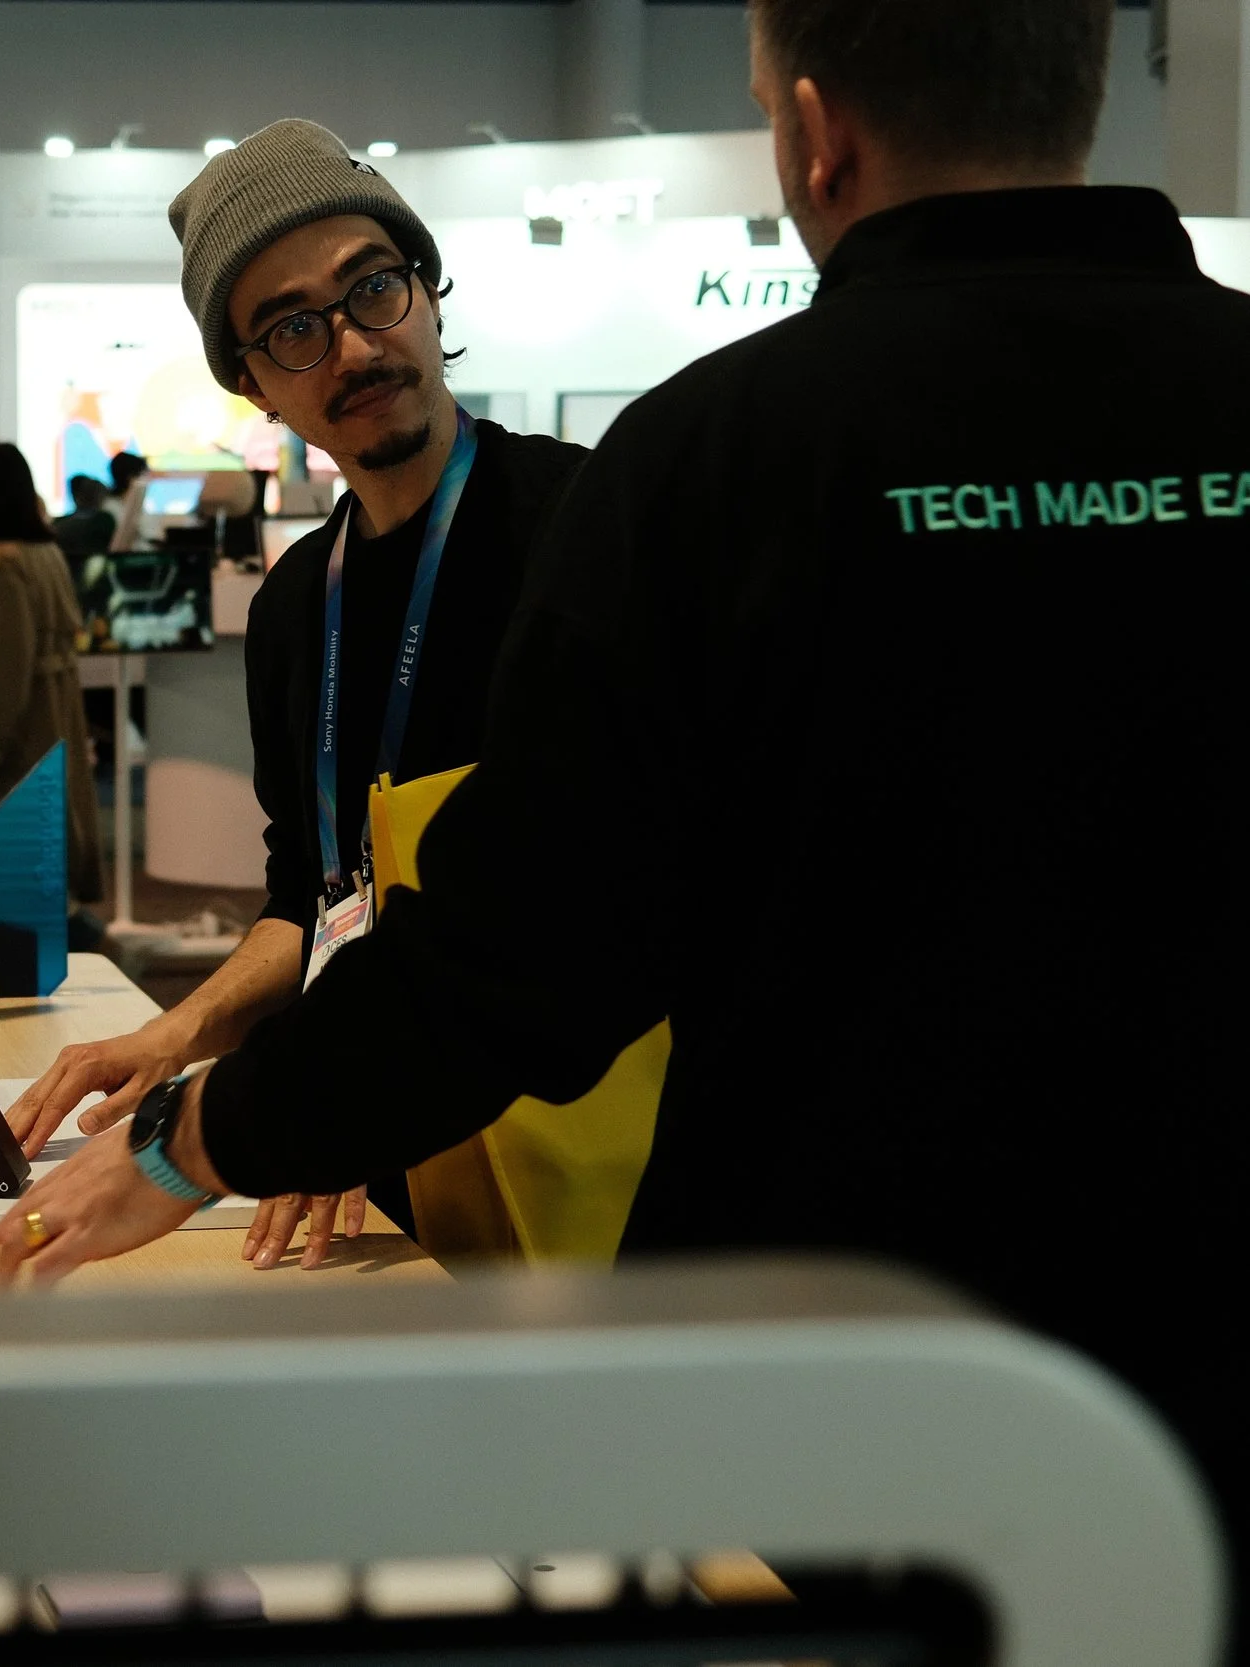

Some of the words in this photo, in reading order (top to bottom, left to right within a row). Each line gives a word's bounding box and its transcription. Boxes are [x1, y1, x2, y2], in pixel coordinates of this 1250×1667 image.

[884, 484, 1022, 533] TECH
[1034, 477, 1188, 527] MADE
[328, 630, 339, 678] Mobility
[399, 624, 420, 686] AFEELA
[325, 682, 335, 720] Honda
[323, 723, 334, 752] Sony
